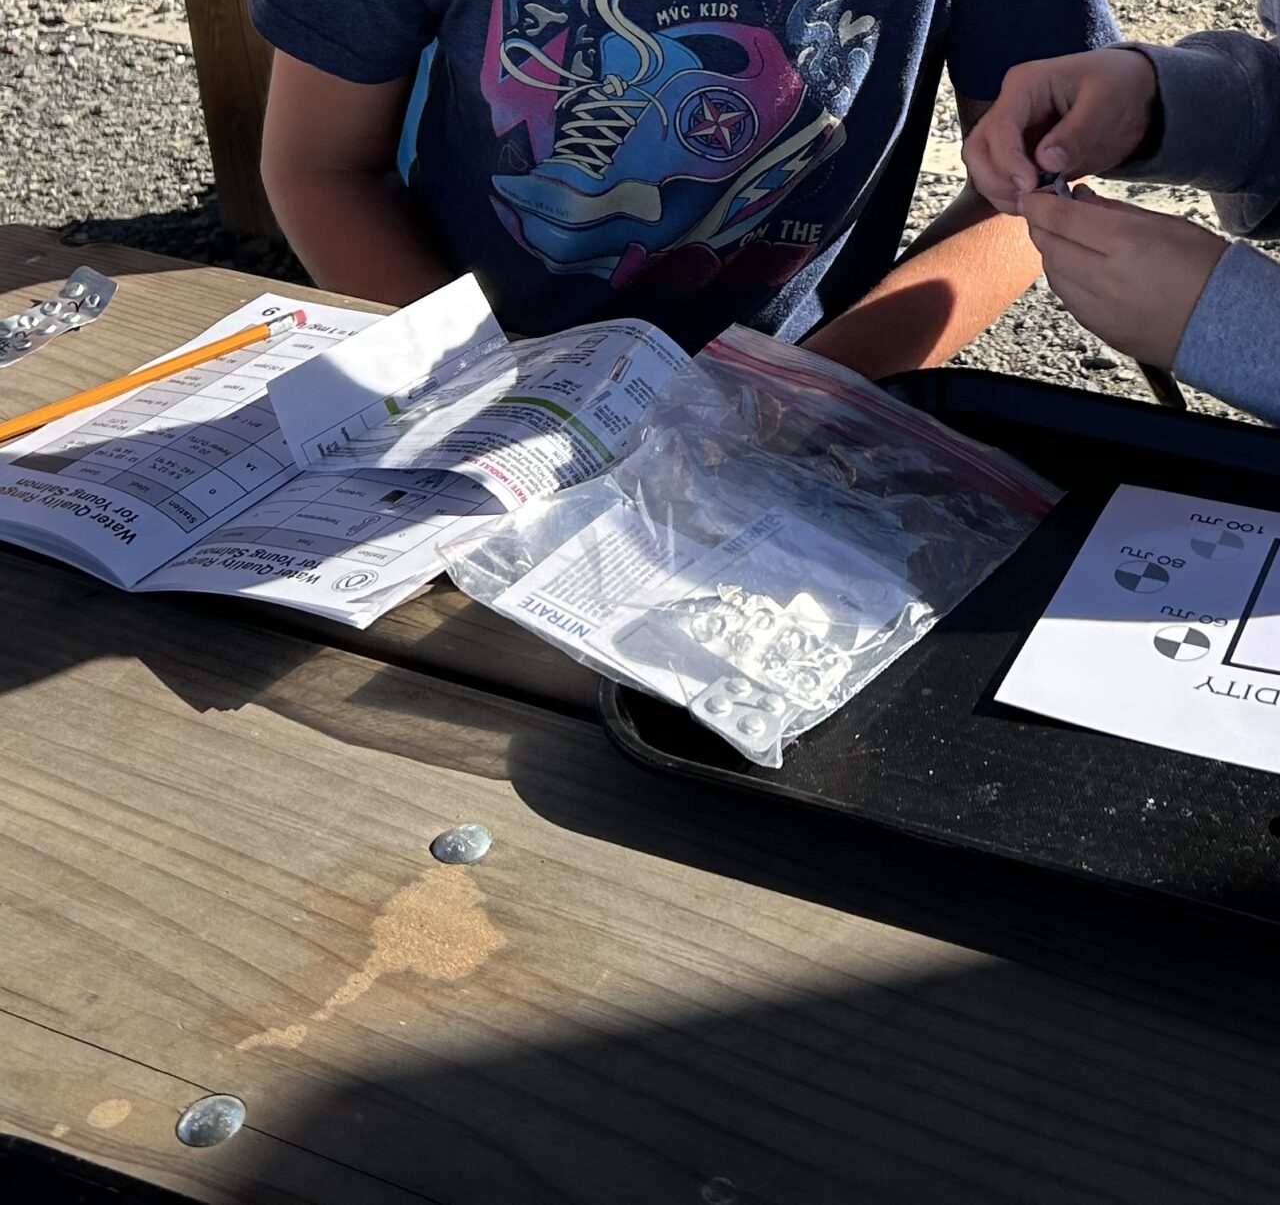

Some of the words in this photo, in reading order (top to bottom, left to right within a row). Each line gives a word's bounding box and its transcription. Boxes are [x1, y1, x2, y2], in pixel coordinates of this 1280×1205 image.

[656, 5, 691, 26] MVC
[700, 2, 739, 20] KIDS
[780, 219, 823, 243] THE
[15, 478, 69, 496] Salmon
[39, 494, 91, 517] Quality
[68, 488, 113, 511] Young
[112, 507, 139, 523] for
[168, 500, 198, 525] Station
[1189, 512, 1223, 525] JTU
[90, 510, 137, 545] Water
[722, 513, 780, 555] NITRATE
[1226, 520, 1264, 534] 100
[252, 549, 296, 566] Young
[1119, 544, 1154, 560] JTU
[218, 559, 275, 575] Quality
[296, 560, 322, 570] for
[1156, 555, 1186, 569] 80
[274, 569, 321, 585] Water
[516, 595, 590, 639] NITRATE
[1159, 604, 1196, 619] JTU
[1199, 614, 1228, 628] 60
